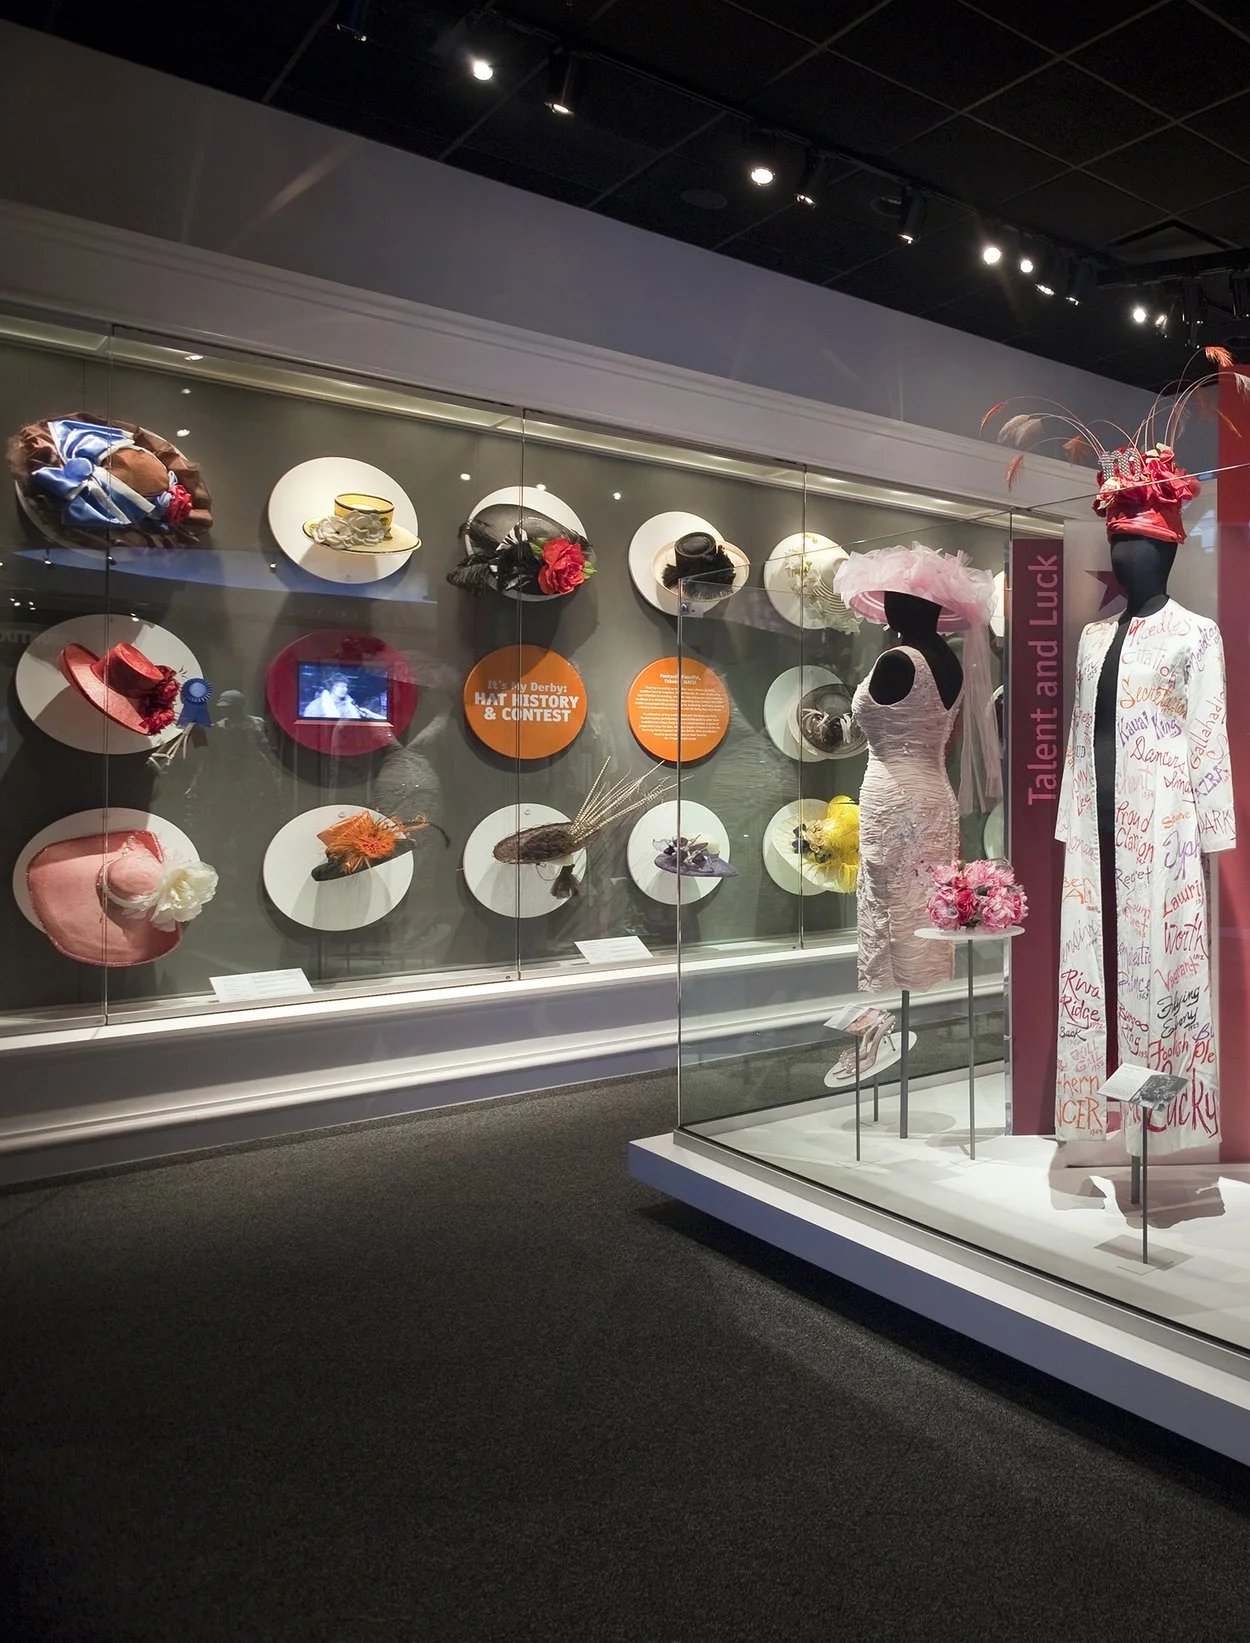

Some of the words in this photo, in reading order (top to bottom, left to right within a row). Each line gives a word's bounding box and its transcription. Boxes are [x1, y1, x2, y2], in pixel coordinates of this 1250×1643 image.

[1027, 554, 1058, 626] Luck
[1027, 640, 1058, 697] and
[475, 692, 507, 705] HAT
[512, 692, 580, 709] HISTORY
[487, 680, 509, 691] It's
[511, 681, 527, 694] My
[530, 681, 568, 695] Derby:
[483, 707, 497, 721] &
[501, 708, 571, 722] CONTEST
[1151, 712, 1182, 741] King
[1189, 691, 1225, 769] Gallahadio
[1027, 708, 1057, 805] Talent
[1116, 800, 1154, 832] Proud
[1164, 913, 1209, 958] Worth
[1061, 969, 1101, 1001] Riva
[1059, 994, 1101, 1030] Ridge
[1149, 1031, 1188, 1070] Foolish
[1147, 1060, 1218, 1138] Lucky
